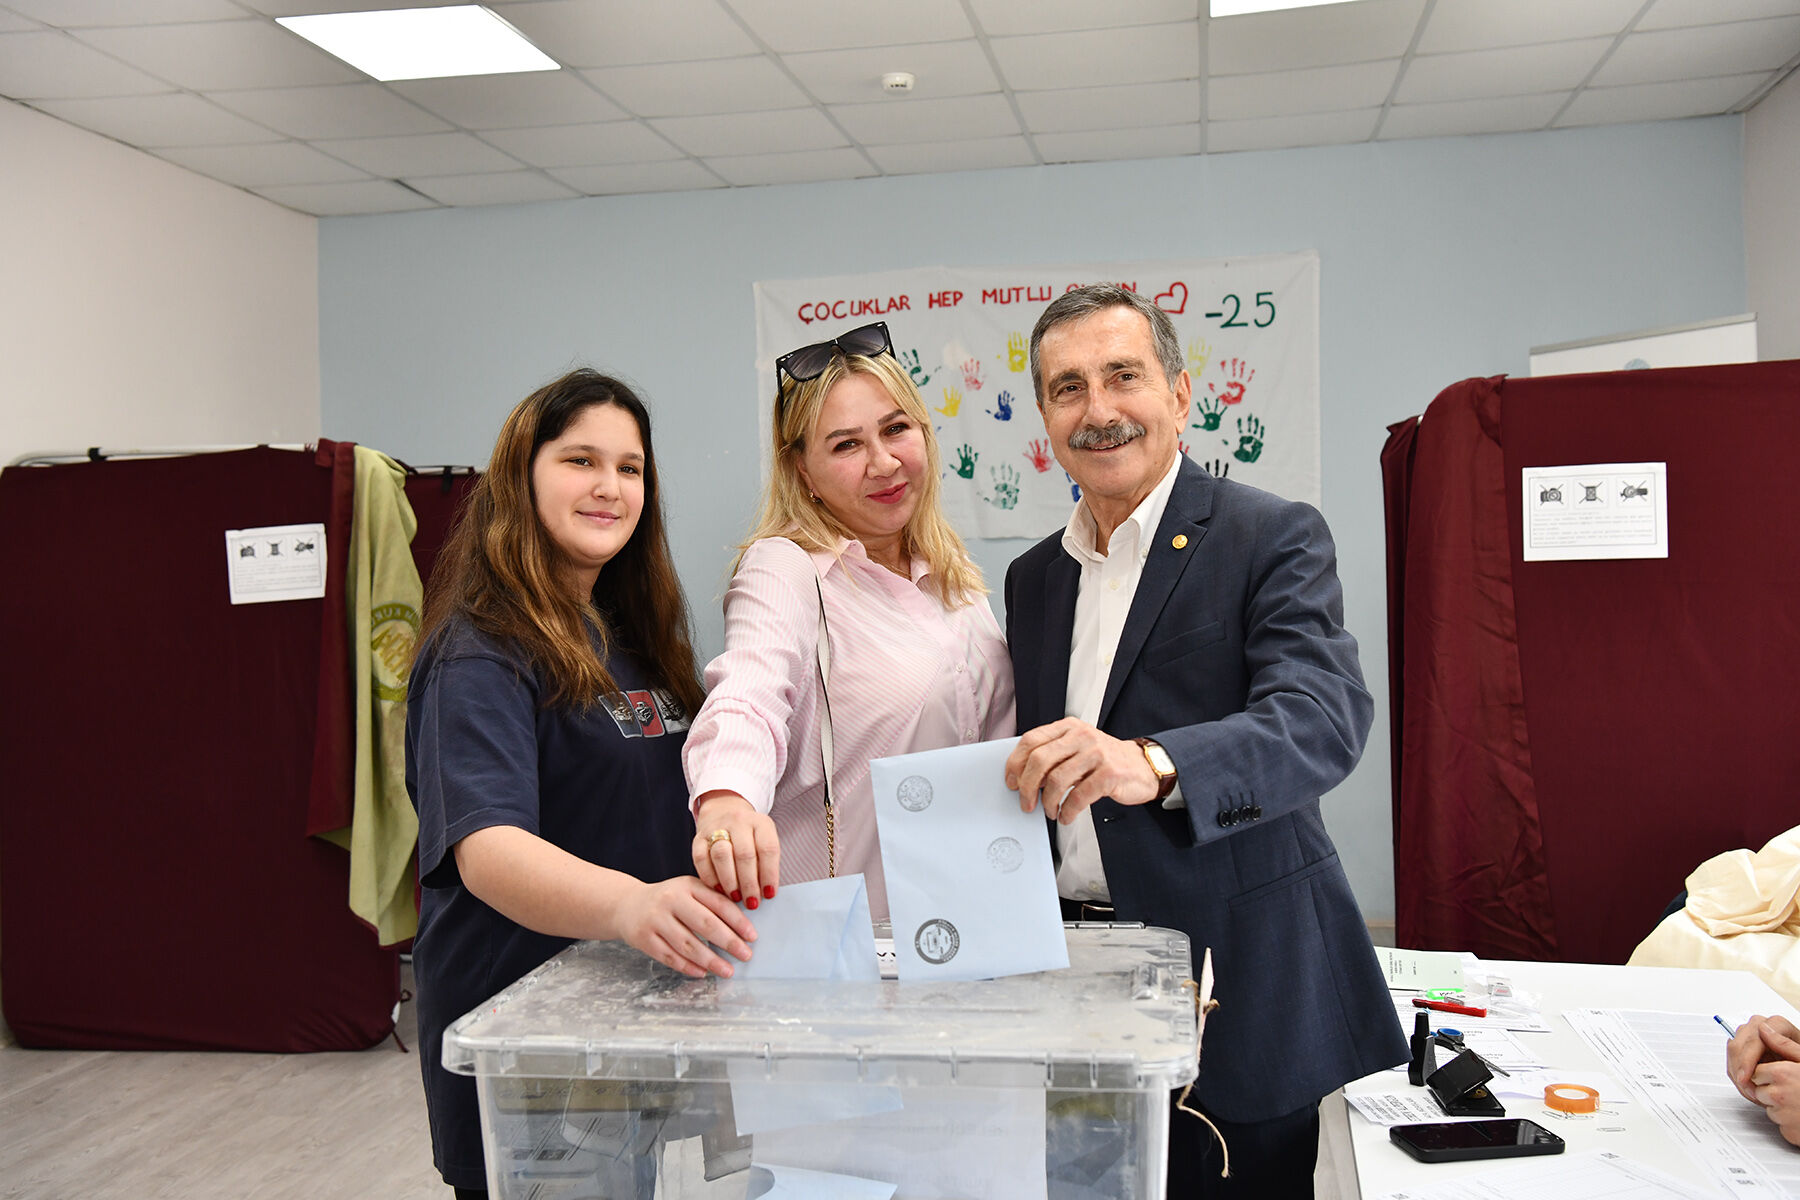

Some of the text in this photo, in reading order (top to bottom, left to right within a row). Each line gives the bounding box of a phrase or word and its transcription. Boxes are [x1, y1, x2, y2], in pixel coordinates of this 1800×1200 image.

[797, 294, 911, 325] ÇOCUKLAR
[928, 290, 964, 309] HEP
[981, 285, 1053, 305] MUTLU
